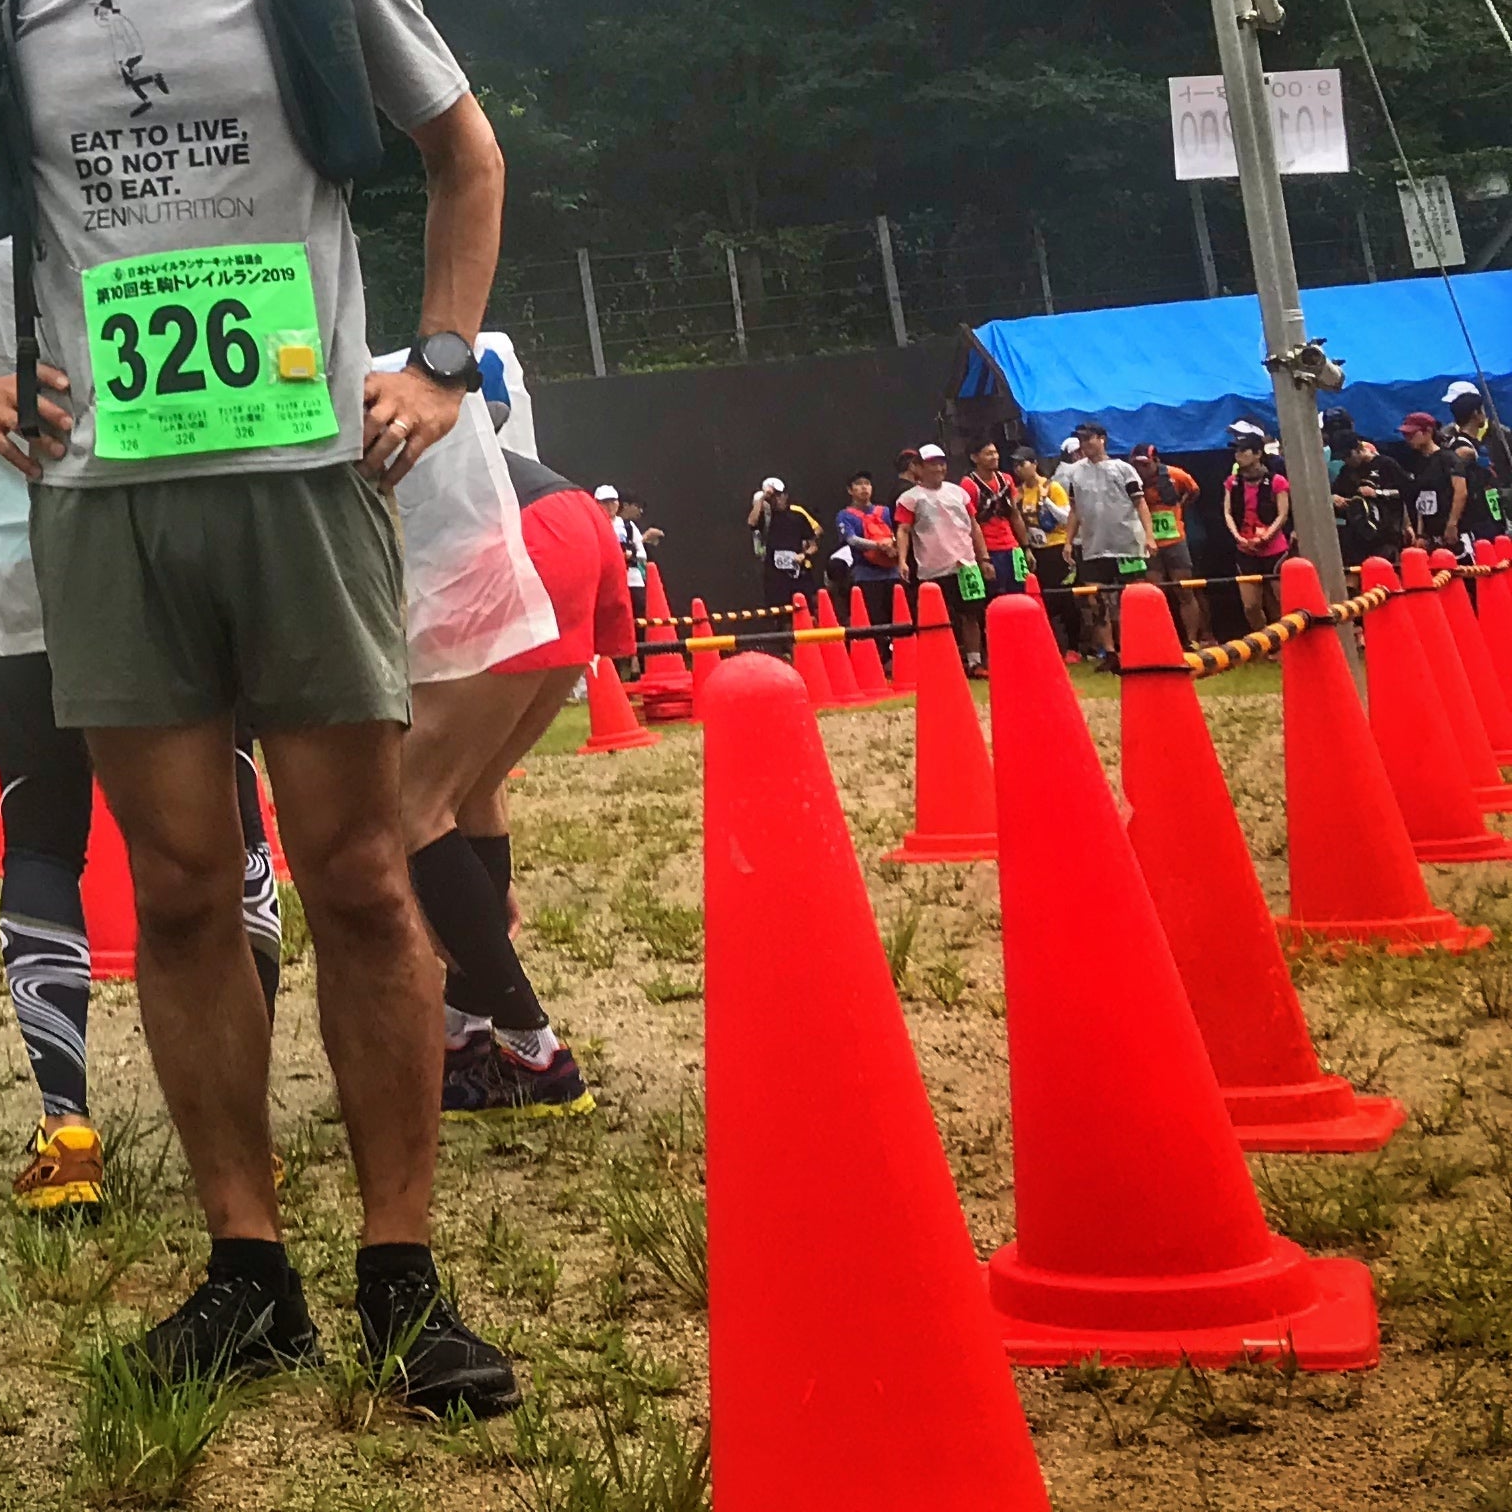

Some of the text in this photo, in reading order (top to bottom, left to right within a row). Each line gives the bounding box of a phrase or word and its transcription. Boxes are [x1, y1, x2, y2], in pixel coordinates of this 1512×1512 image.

[71, 118, 248, 154] EAT TO LIVE,
[75, 143, 250, 180] DO NOT LIVE
[81, 176, 181, 205] TO EAT.
[100, 298, 260, 402] 326
[235, 426, 255, 440] 326
[292, 420, 312, 435] 326
[120, 439, 139, 452] 326
[175, 432, 196, 446] 326
